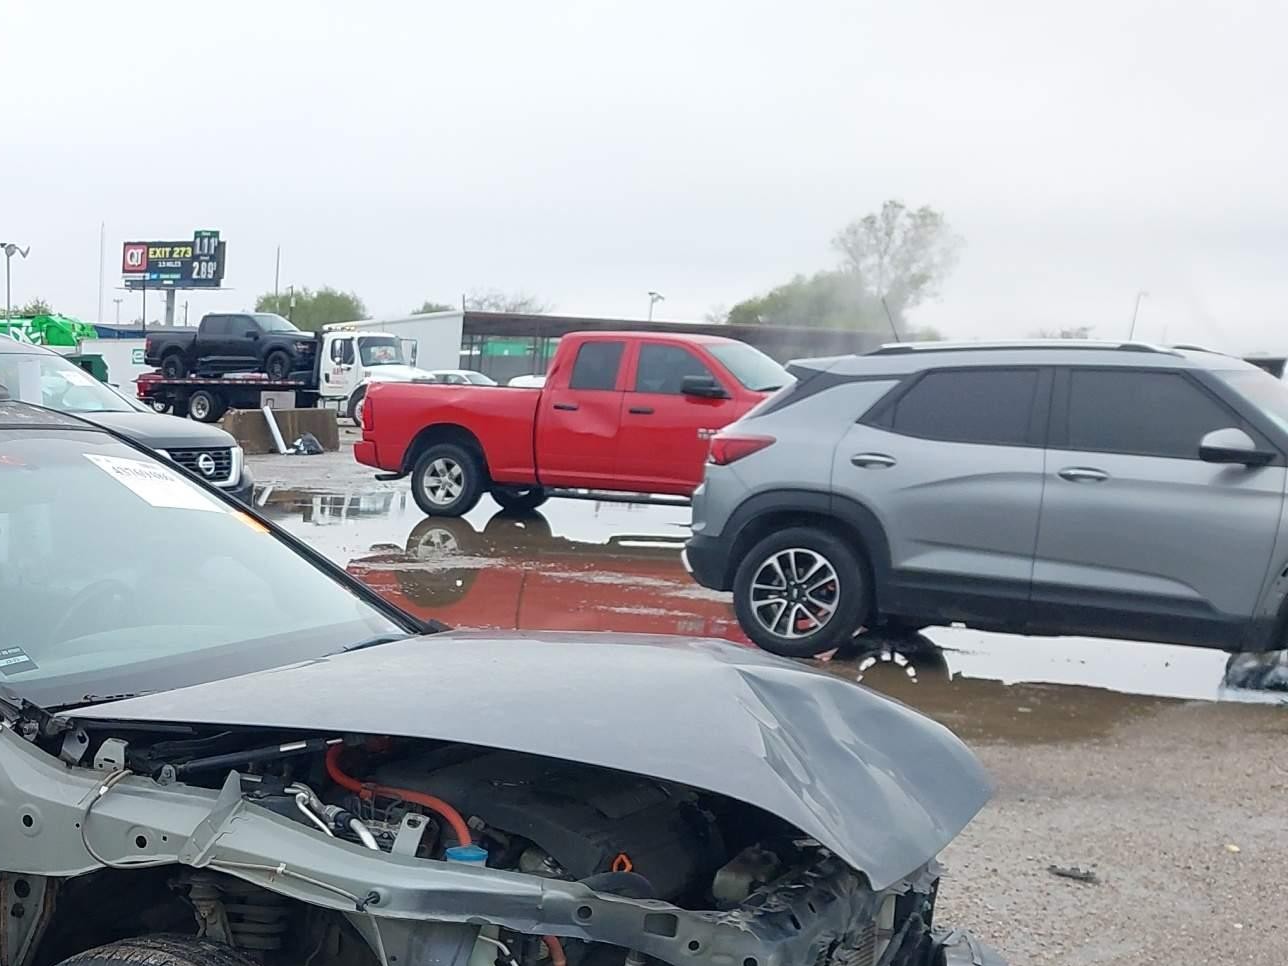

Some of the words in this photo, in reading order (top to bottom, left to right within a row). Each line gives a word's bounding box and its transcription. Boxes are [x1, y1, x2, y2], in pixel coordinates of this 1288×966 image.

[127, 249, 144, 266] QT
[149, 248, 172, 258] EXIT
[173, 247, 192, 258] 273
